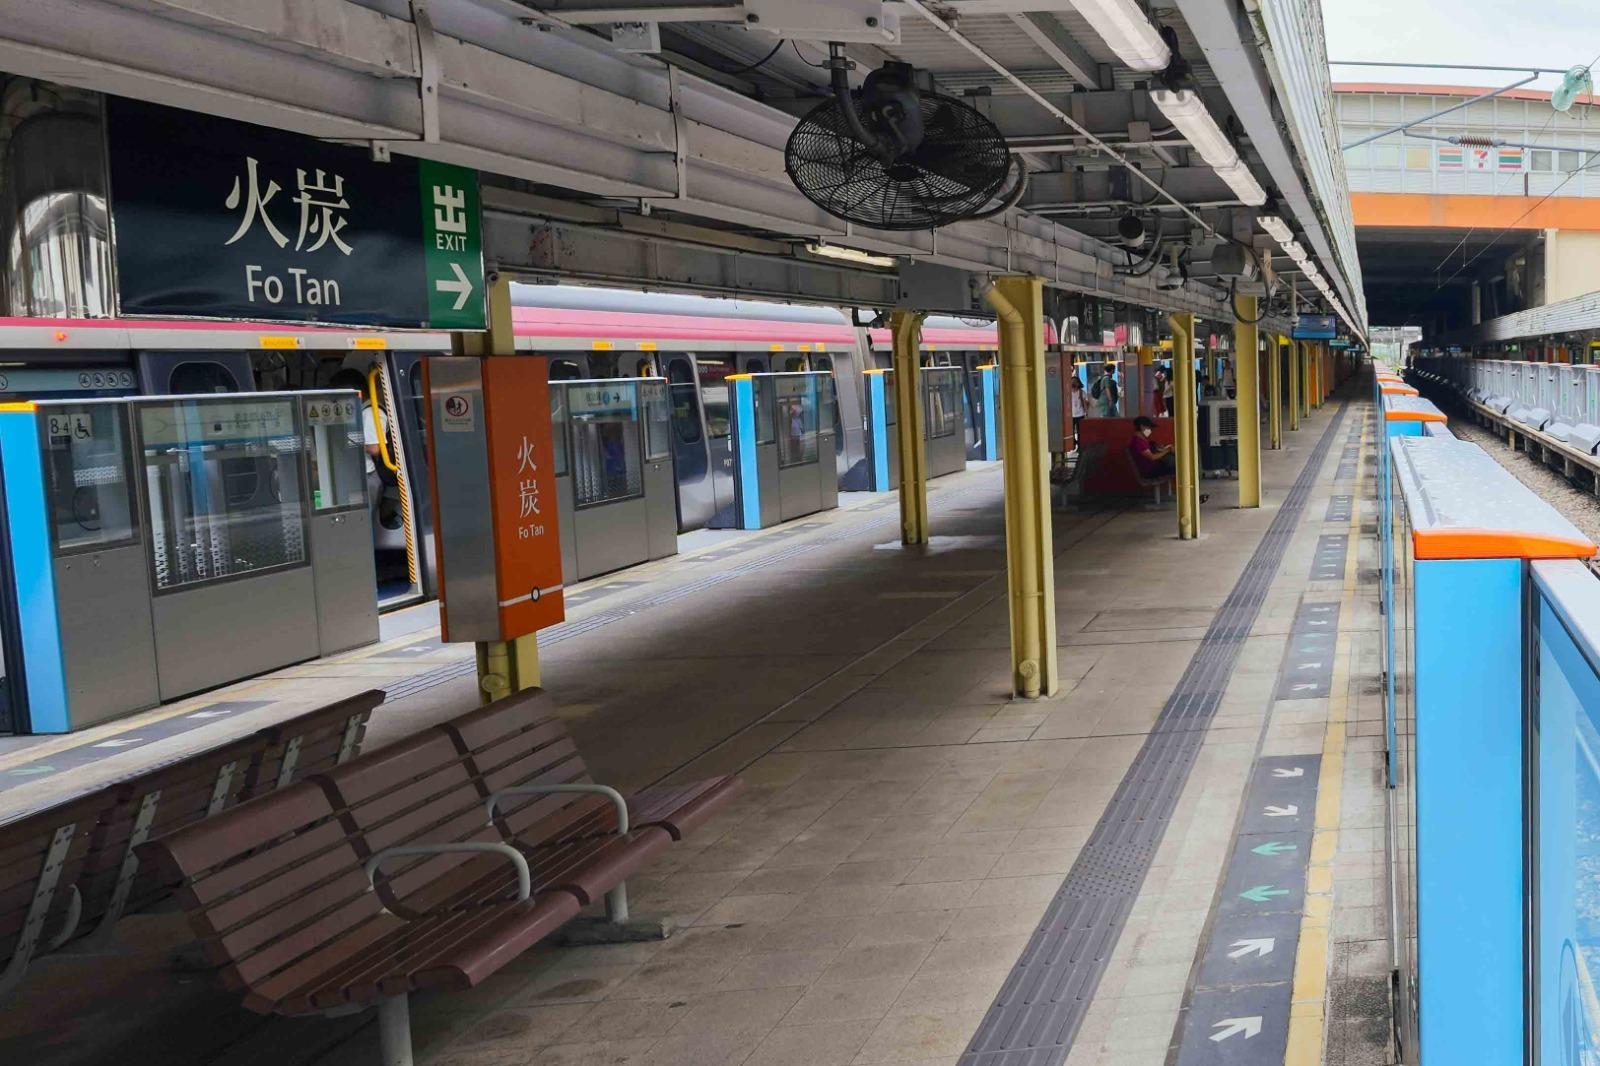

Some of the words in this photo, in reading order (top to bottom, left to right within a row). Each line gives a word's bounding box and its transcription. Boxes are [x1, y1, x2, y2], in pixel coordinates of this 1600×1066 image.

[224, 156, 354, 256] 火炭
[433, 185, 466, 233] 出
[436, 233, 467, 252] EXIT
[245, 264, 284, 304] Fo
[288, 267, 341, 306] Tan
[517, 435, 541, 519] 火炭
[518, 526, 529, 540] Fo
[530, 523, 544, 537] Tan
